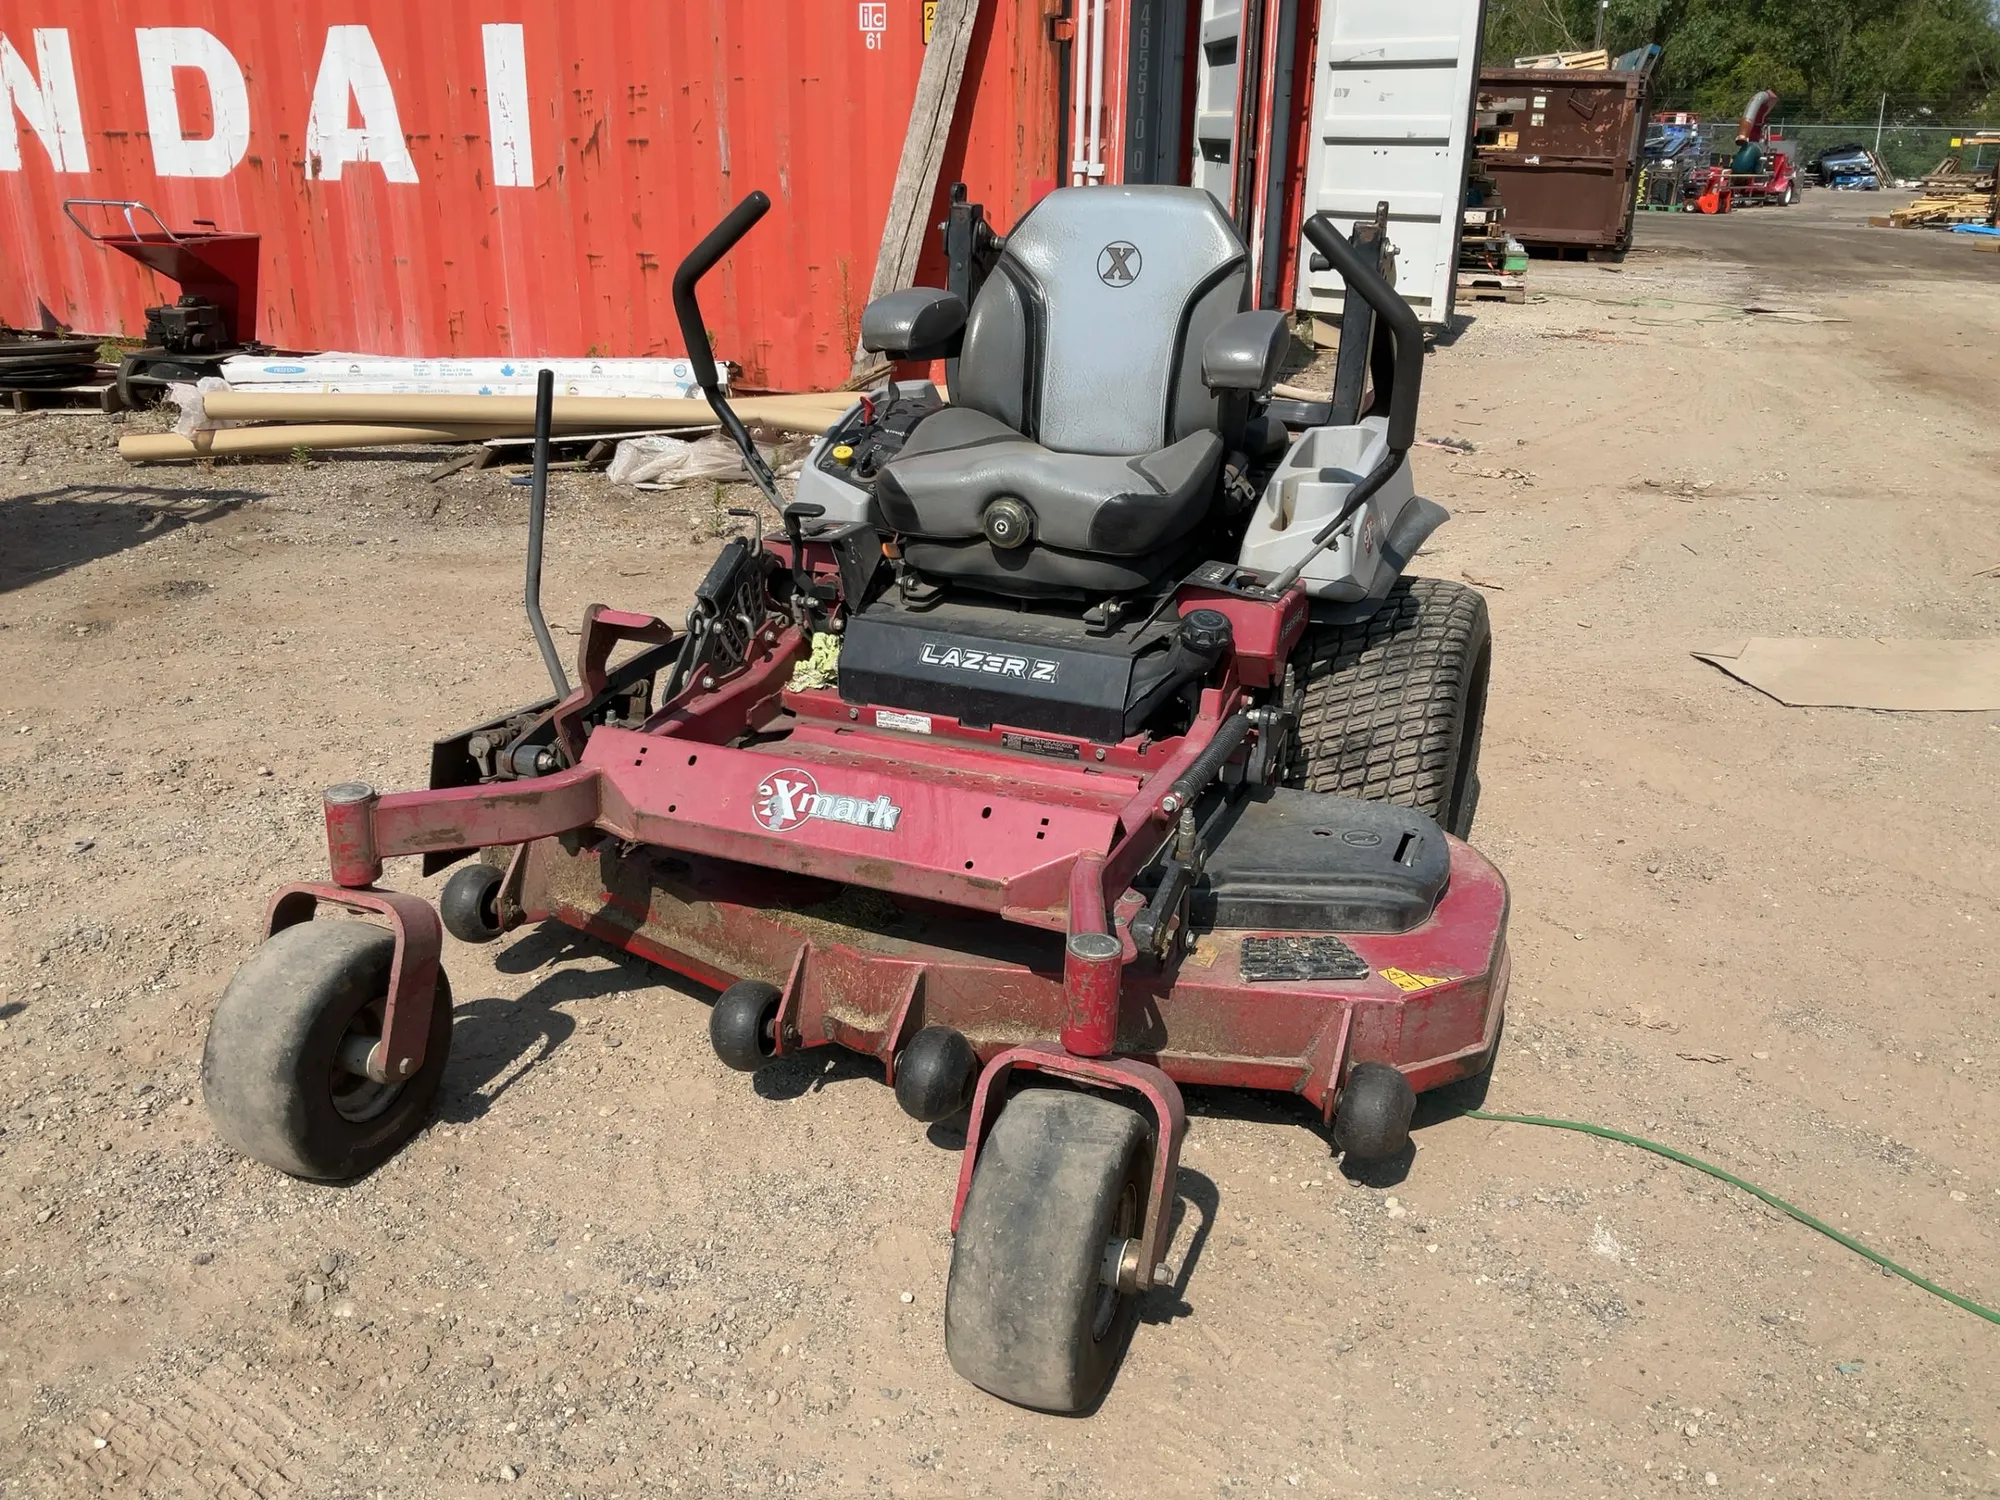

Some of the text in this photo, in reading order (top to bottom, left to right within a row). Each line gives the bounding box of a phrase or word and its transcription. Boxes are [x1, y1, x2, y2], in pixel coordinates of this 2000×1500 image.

[865, 32, 882, 50] 61
[920, 644, 1058, 682] LAZER Z
[757, 778, 902, 831] eXmark
